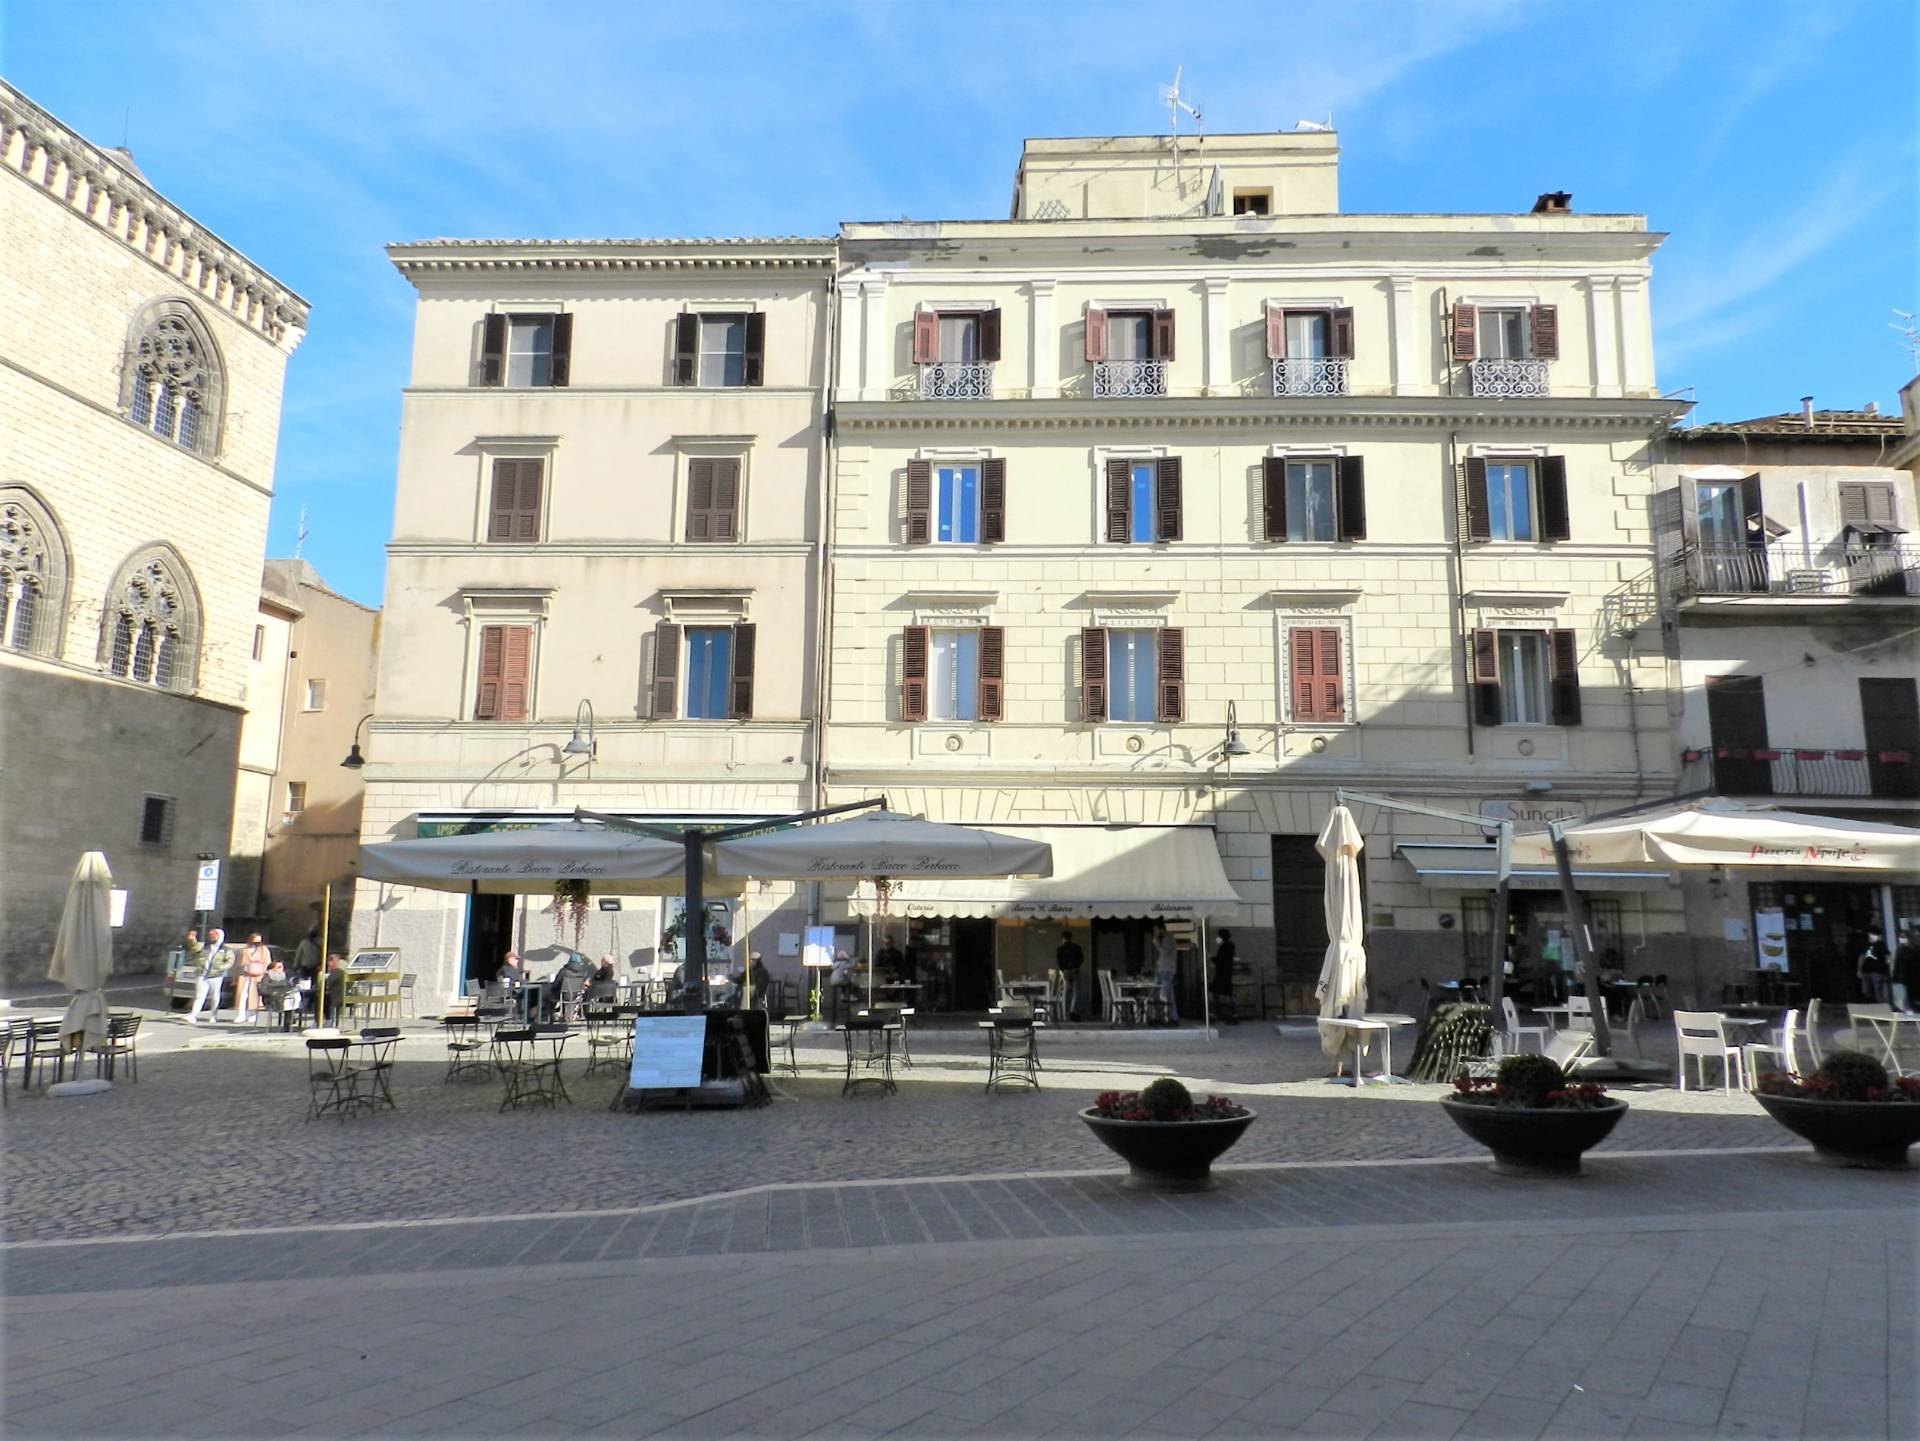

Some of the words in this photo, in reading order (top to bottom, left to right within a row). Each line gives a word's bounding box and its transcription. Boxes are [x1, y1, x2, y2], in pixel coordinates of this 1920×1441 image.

[808, 855, 866, 871] Ristorante
[872, 855, 908, 871] Bacco
[912, 855, 960, 871] Perbacco
[906, 902, 934, 912] Osteria
